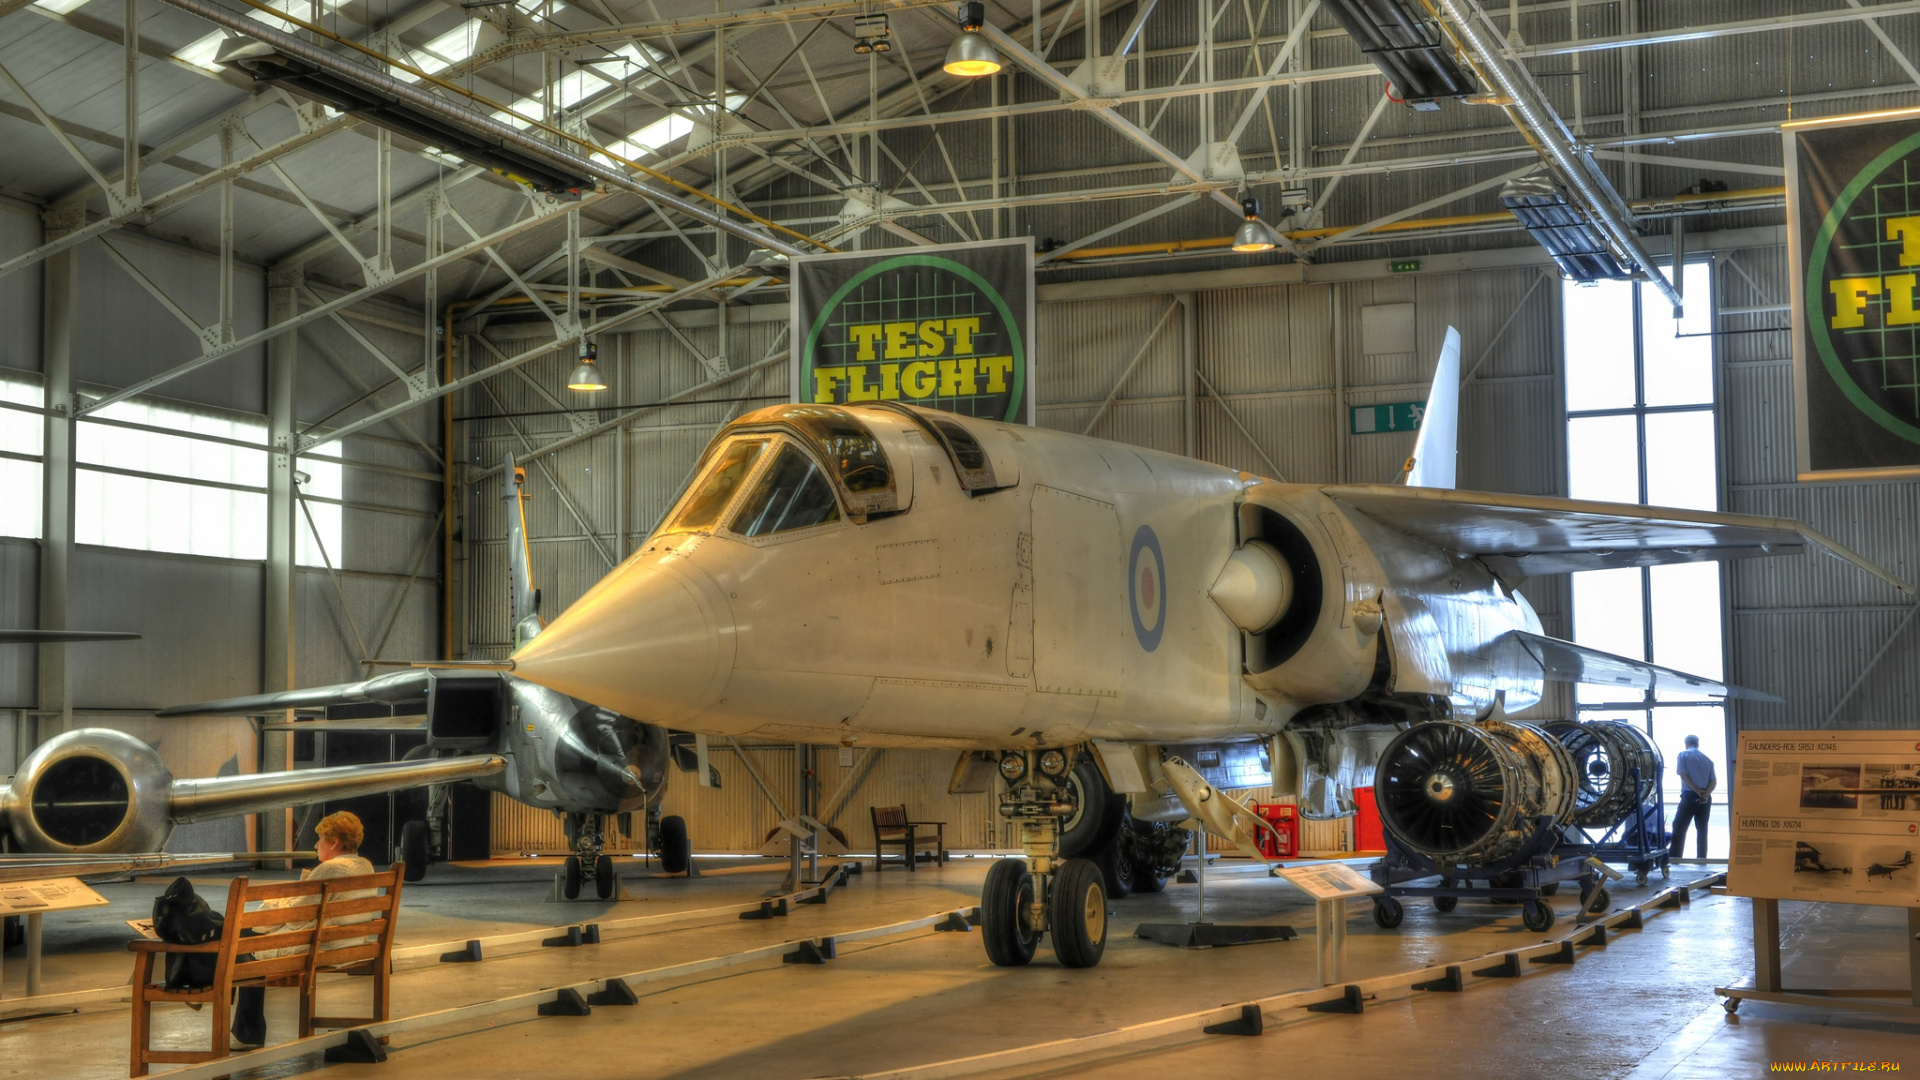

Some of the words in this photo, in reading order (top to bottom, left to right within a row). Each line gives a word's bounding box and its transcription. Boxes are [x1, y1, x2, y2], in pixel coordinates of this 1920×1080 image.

[850, 317, 980, 361] TEST
[814, 356, 1013, 403] FLIGHT
[1748, 742, 1796, 751] SAUNDERS-ROE
[1798, 742, 1815, 751] SR53
[1816, 742, 1837, 751] XD145
[1741, 819, 1769, 828] HUNTING
[1771, 820, 1781, 828] 126
[1782, 820, 1802, 829] XN714
